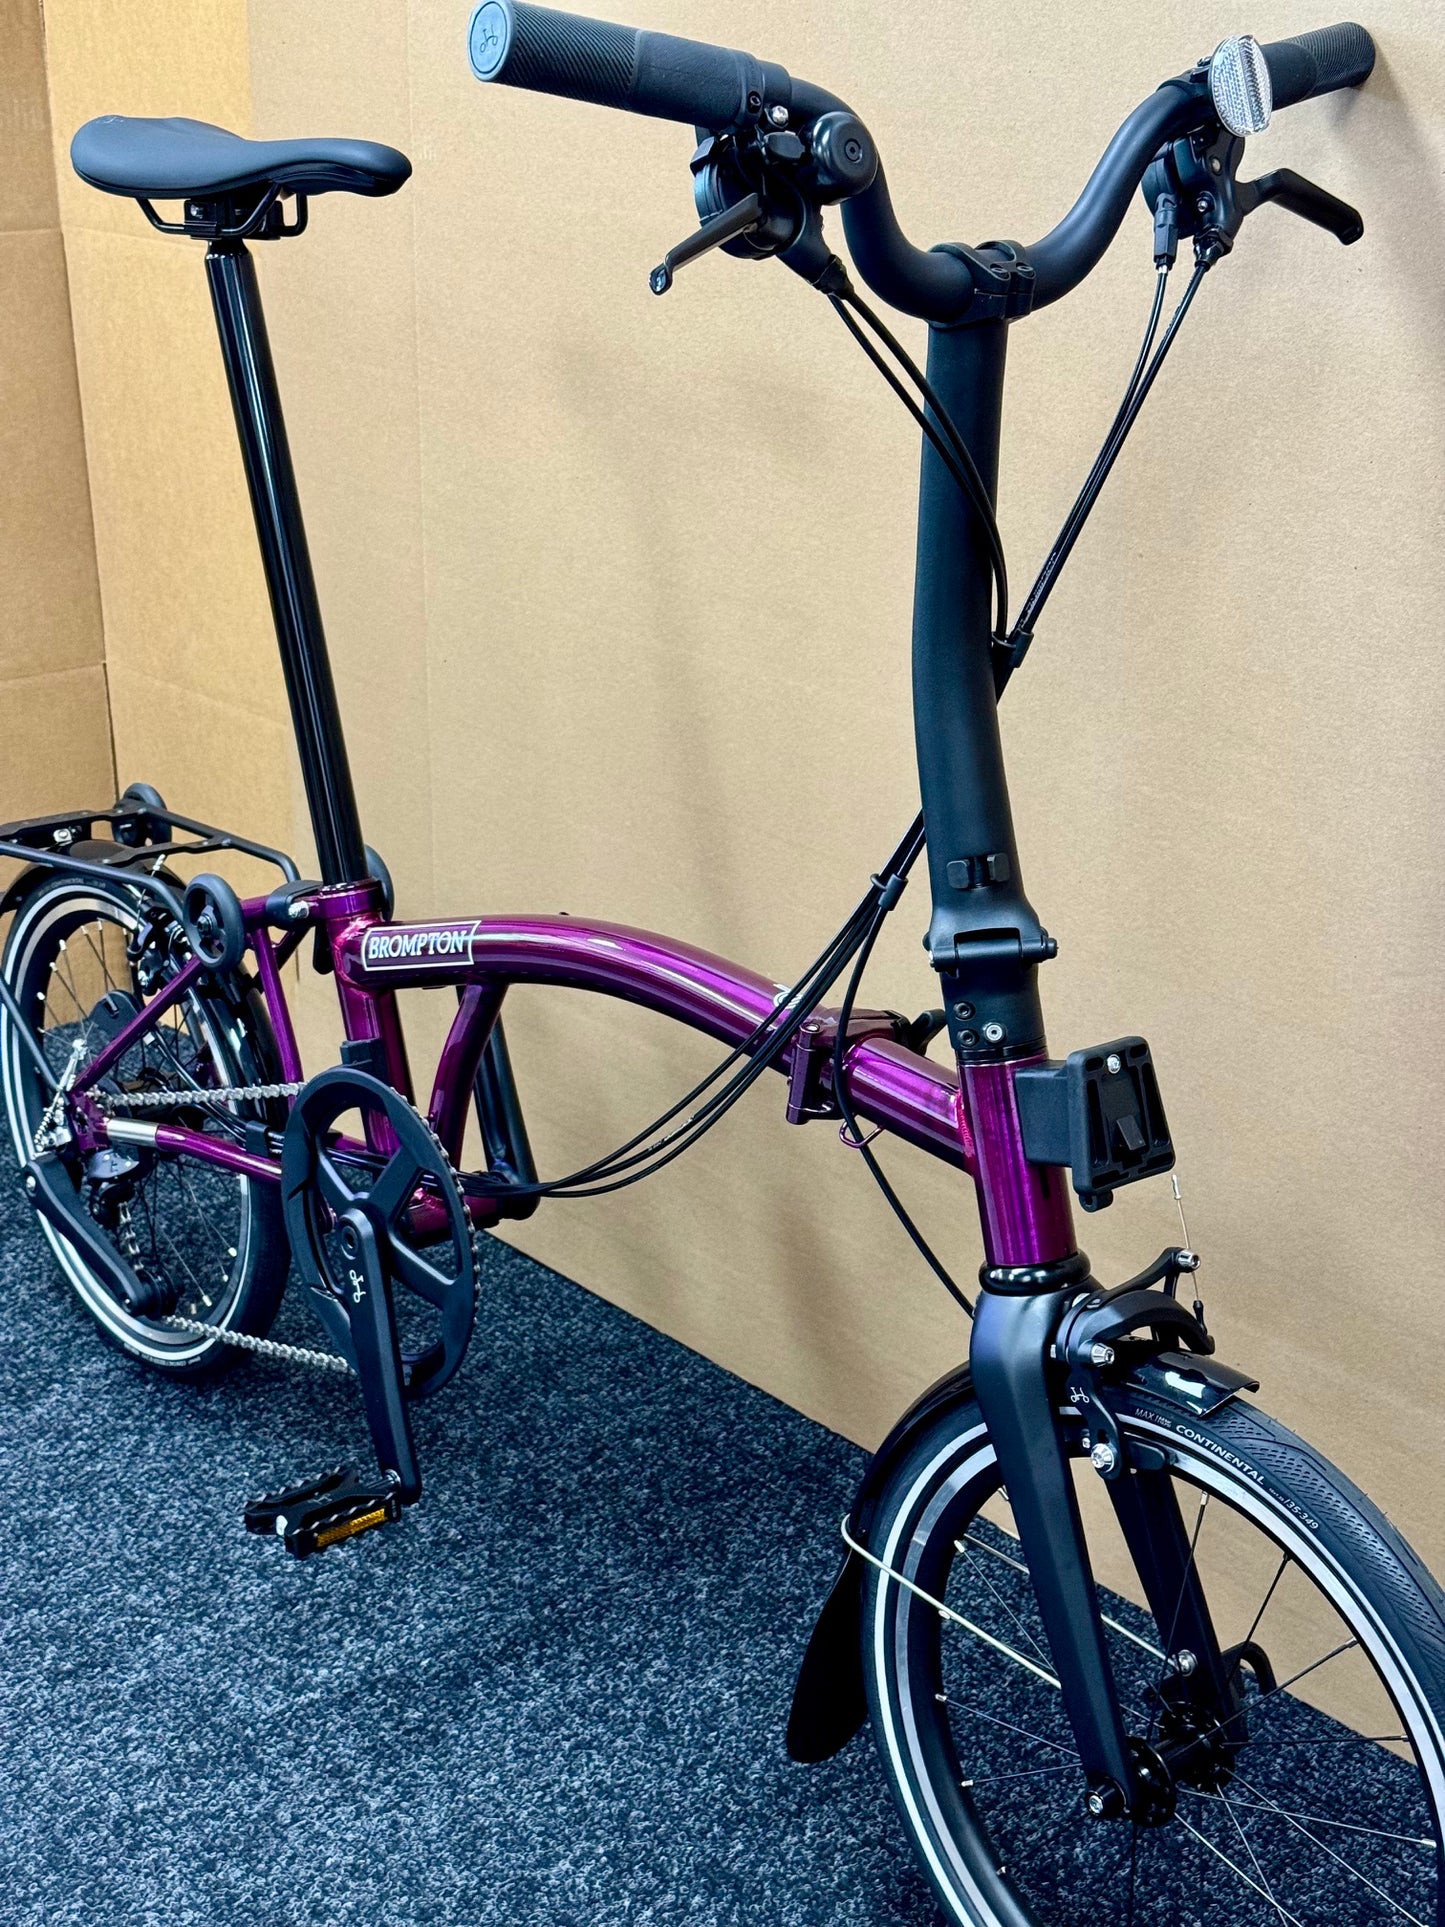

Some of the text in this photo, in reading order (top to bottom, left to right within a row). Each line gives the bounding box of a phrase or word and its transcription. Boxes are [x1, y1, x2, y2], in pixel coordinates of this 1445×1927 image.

[368, 930, 467, 959] BROMPTON
[1135, 1407, 1155, 1421] MAX
[1175, 1424, 1265, 1485] CONTINENTAL
